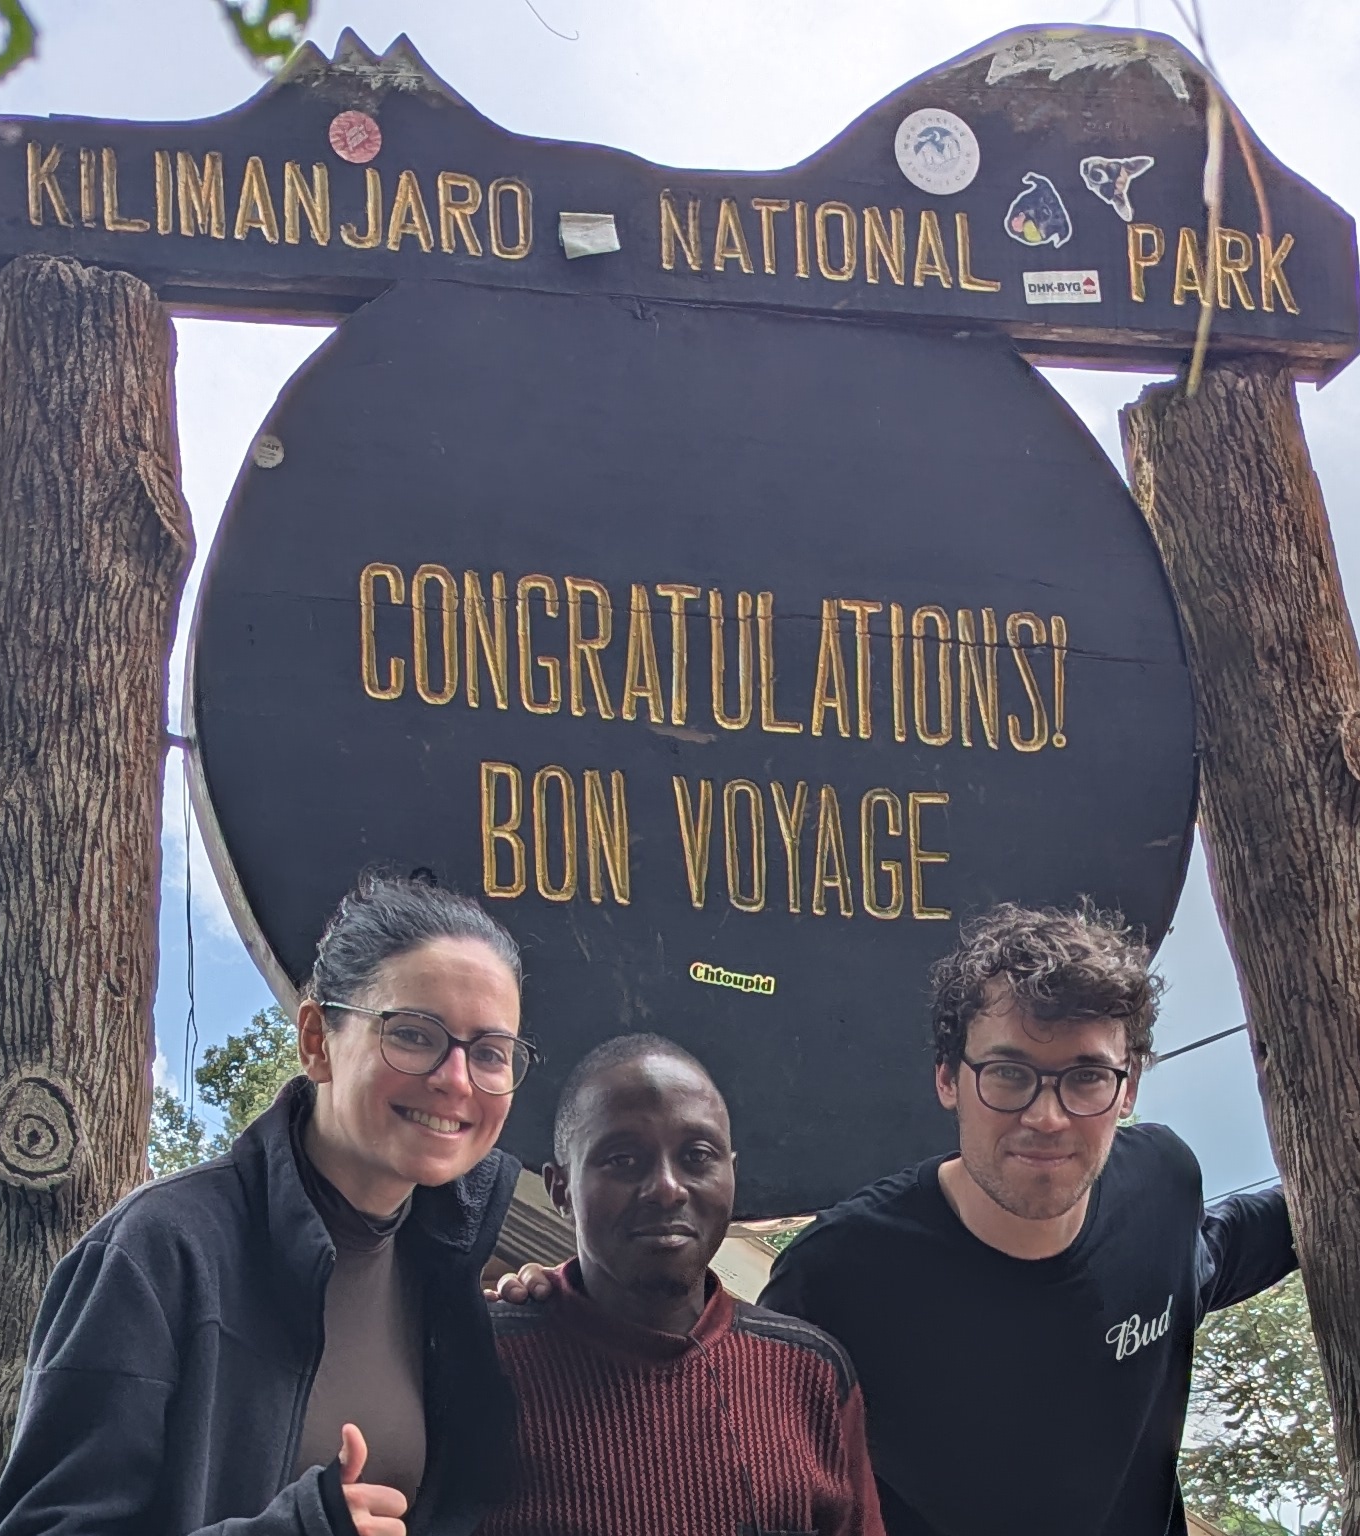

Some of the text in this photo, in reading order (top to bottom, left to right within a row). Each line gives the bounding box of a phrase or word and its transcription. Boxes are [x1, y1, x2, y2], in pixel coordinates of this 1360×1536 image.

[27, 140, 1301, 315] KILIMANJARO NATIONAL PARK
[1027, 282, 1082, 293] DHK-BYG
[359, 562, 1068, 753] CONGRATULATIONS!
[480, 761, 953, 921] BON VOYAGE
[691, 963, 774, 992] Chtoupid
[1105, 1294, 1173, 1361] Bud
